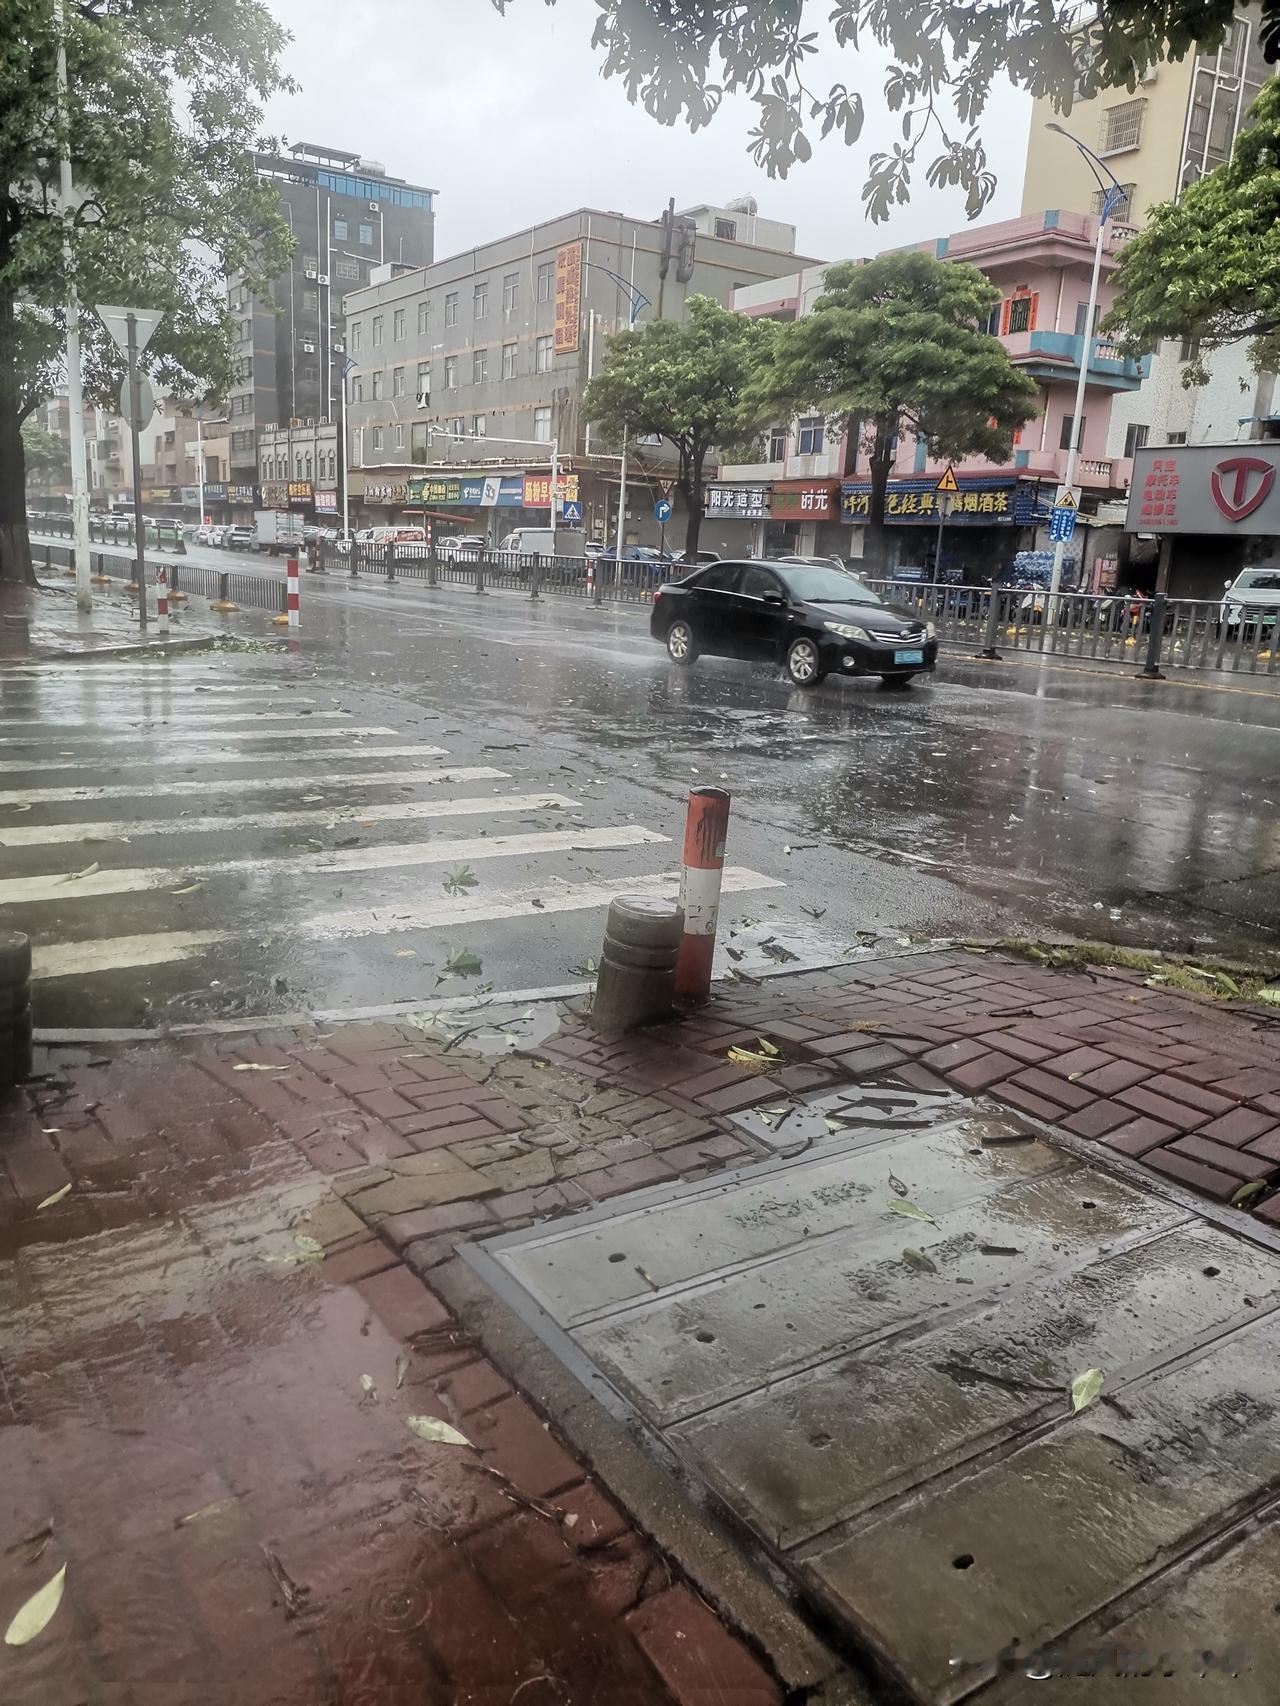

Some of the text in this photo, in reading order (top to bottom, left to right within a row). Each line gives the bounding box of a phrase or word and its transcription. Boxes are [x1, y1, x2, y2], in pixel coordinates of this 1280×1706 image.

[711, 488, 763, 508] 阳光造型
[800, 488, 828, 510] 时光
